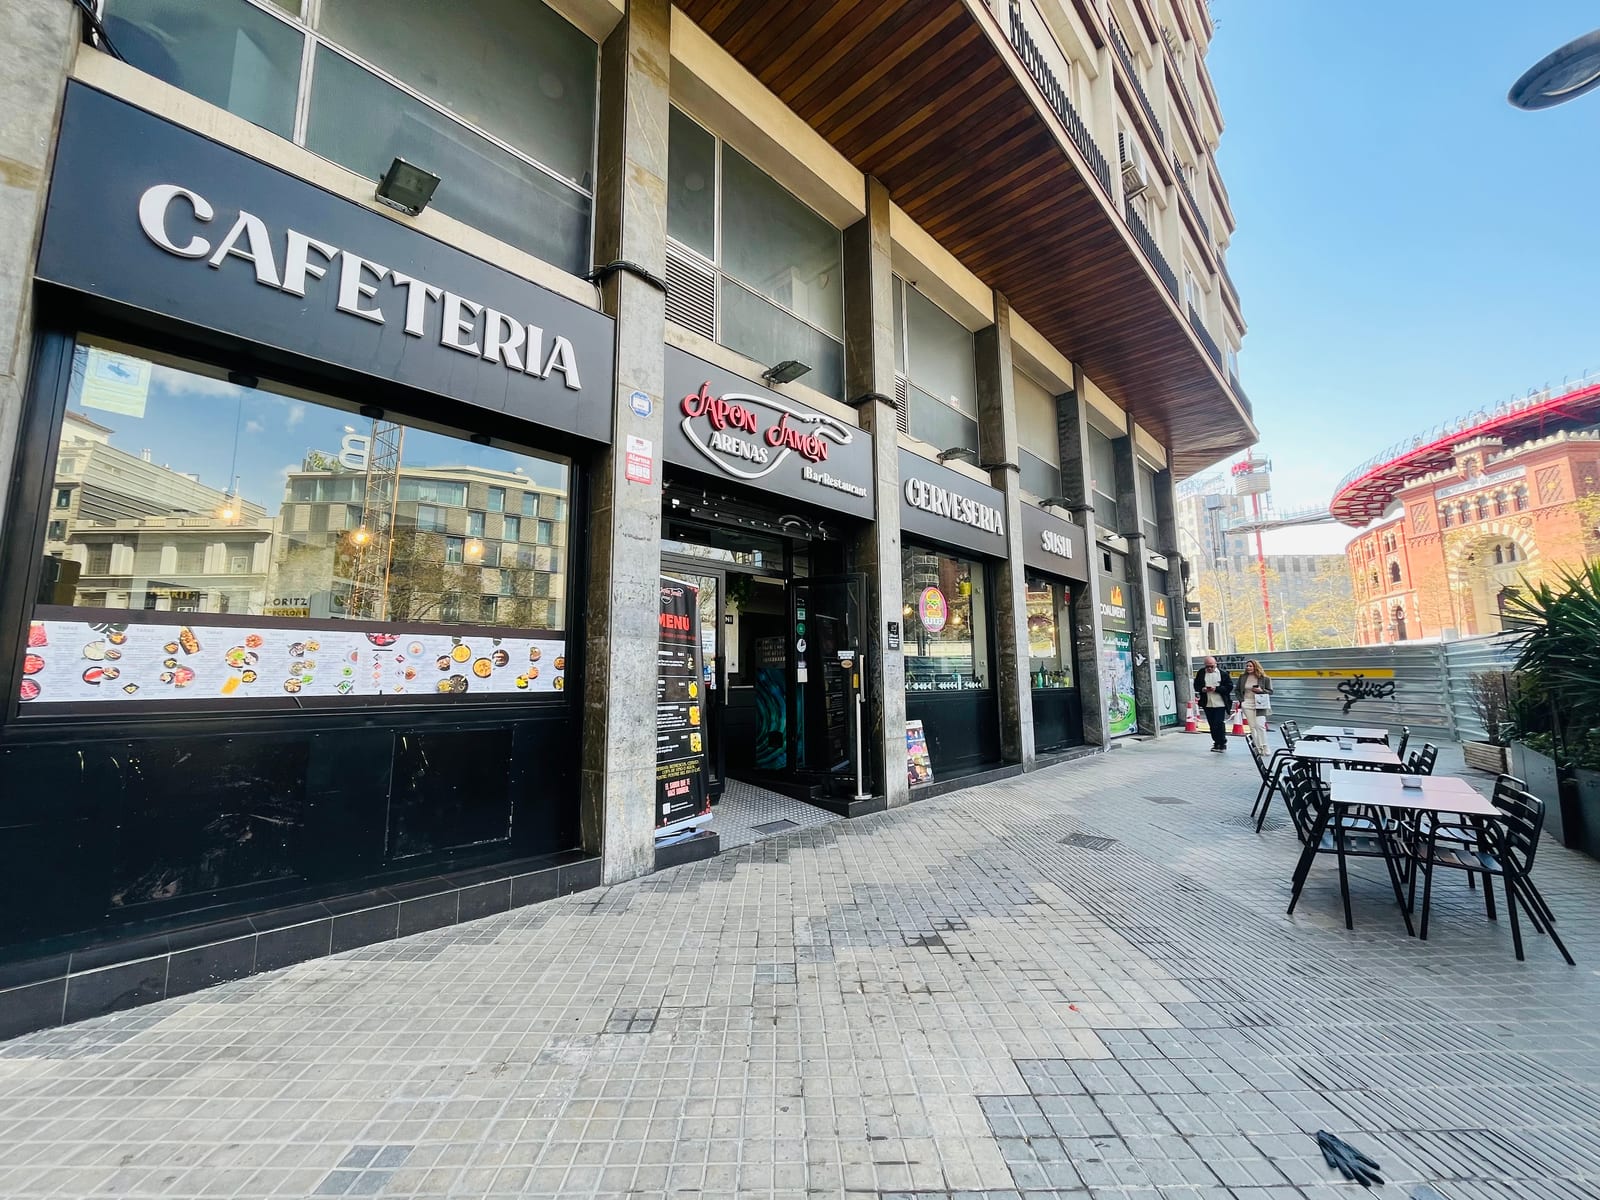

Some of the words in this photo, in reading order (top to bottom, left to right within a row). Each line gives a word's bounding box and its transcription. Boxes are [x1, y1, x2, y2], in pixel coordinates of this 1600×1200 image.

[138, 183, 582, 391] CAFETERIA
[709, 431, 769, 466] ARENAS
[904, 477, 1005, 536] CERVESERIA
[1041, 529, 1073, 560] SUSHI
[268, 597, 308, 606] ORITZ
